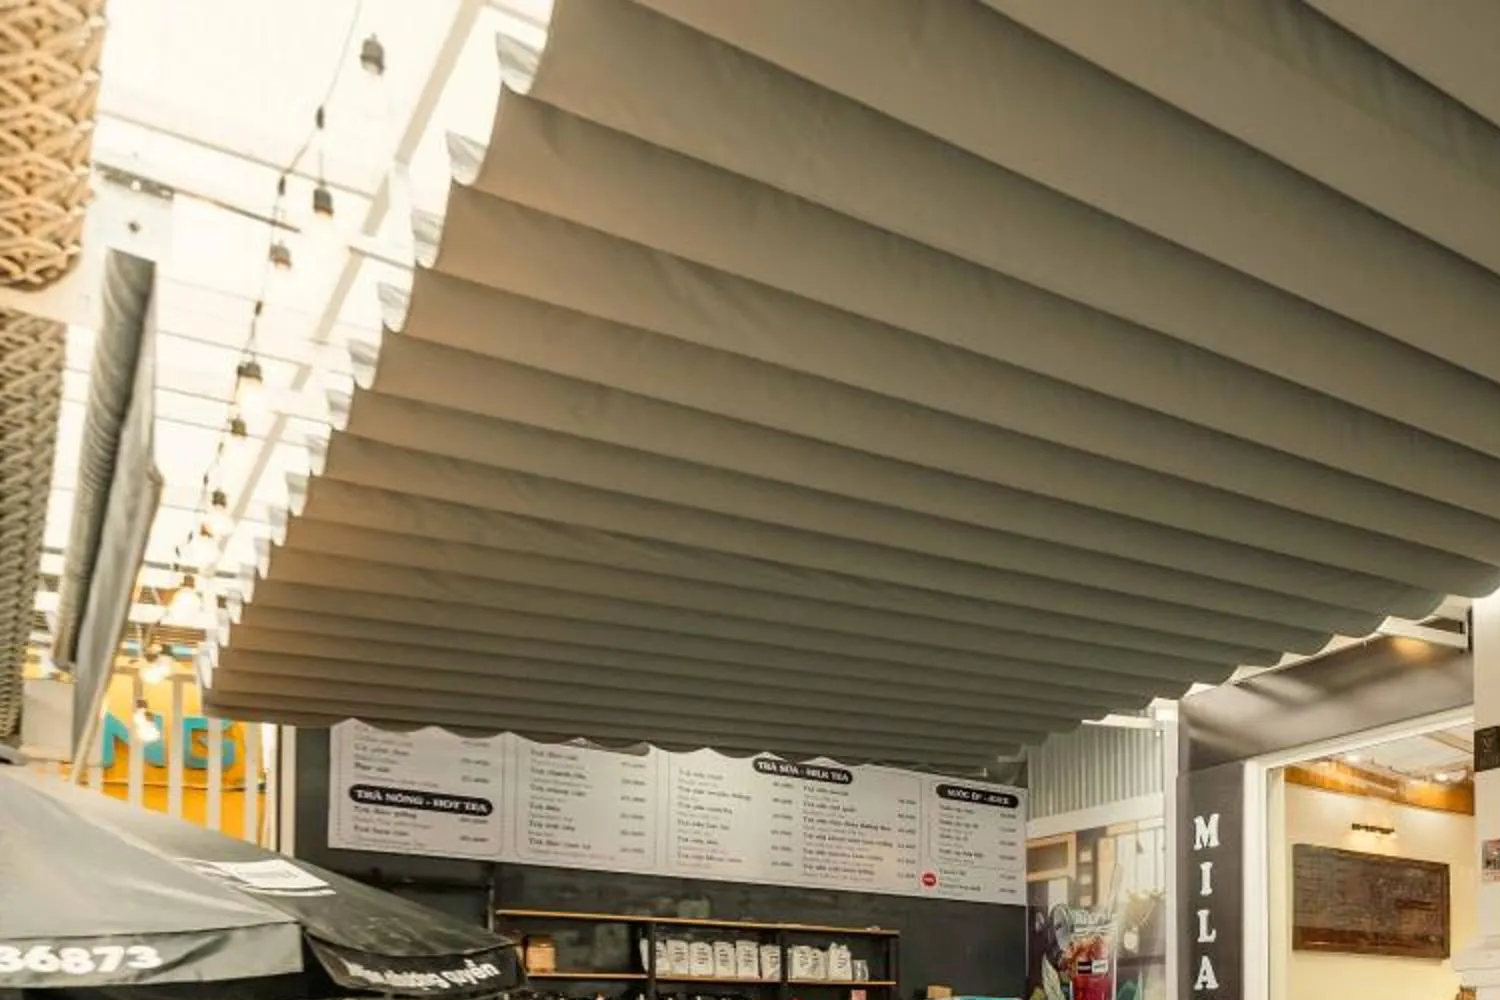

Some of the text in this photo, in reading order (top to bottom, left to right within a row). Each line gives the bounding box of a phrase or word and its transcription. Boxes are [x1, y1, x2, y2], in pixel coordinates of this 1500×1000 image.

[355, 788, 382, 800] TRÀ
[433, 798, 460, 809] HOT
[462, 801, 487, 813] TEA
